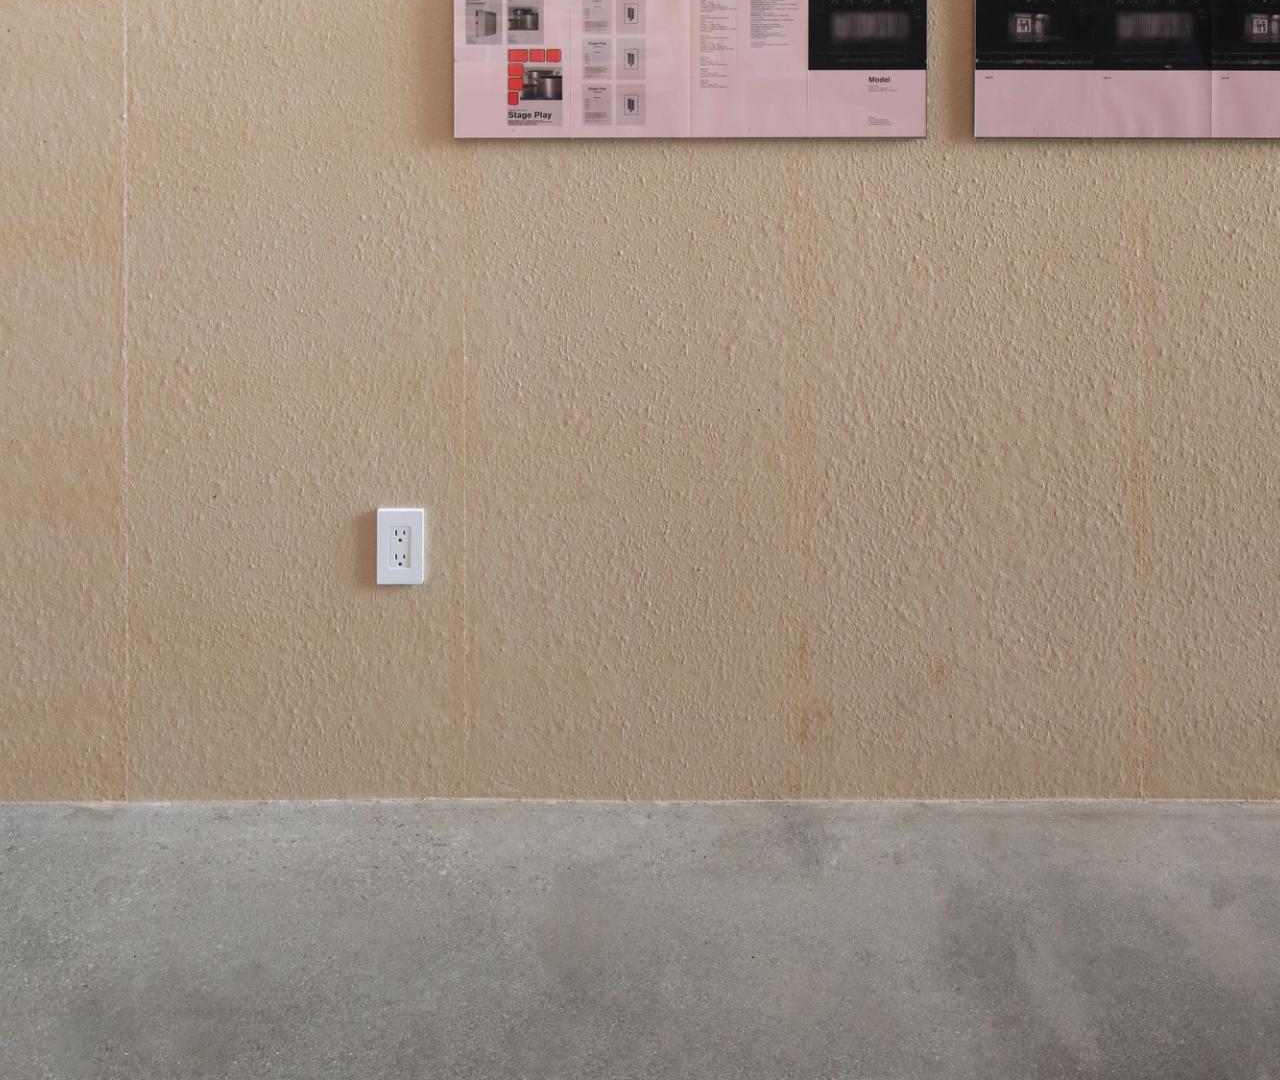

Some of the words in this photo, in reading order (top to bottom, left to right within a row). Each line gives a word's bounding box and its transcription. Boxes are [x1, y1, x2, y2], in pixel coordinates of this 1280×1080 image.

[868, 76, 890, 84] Model
[507, 111, 532, 120] Stage
[533, 111, 552, 120] Play
